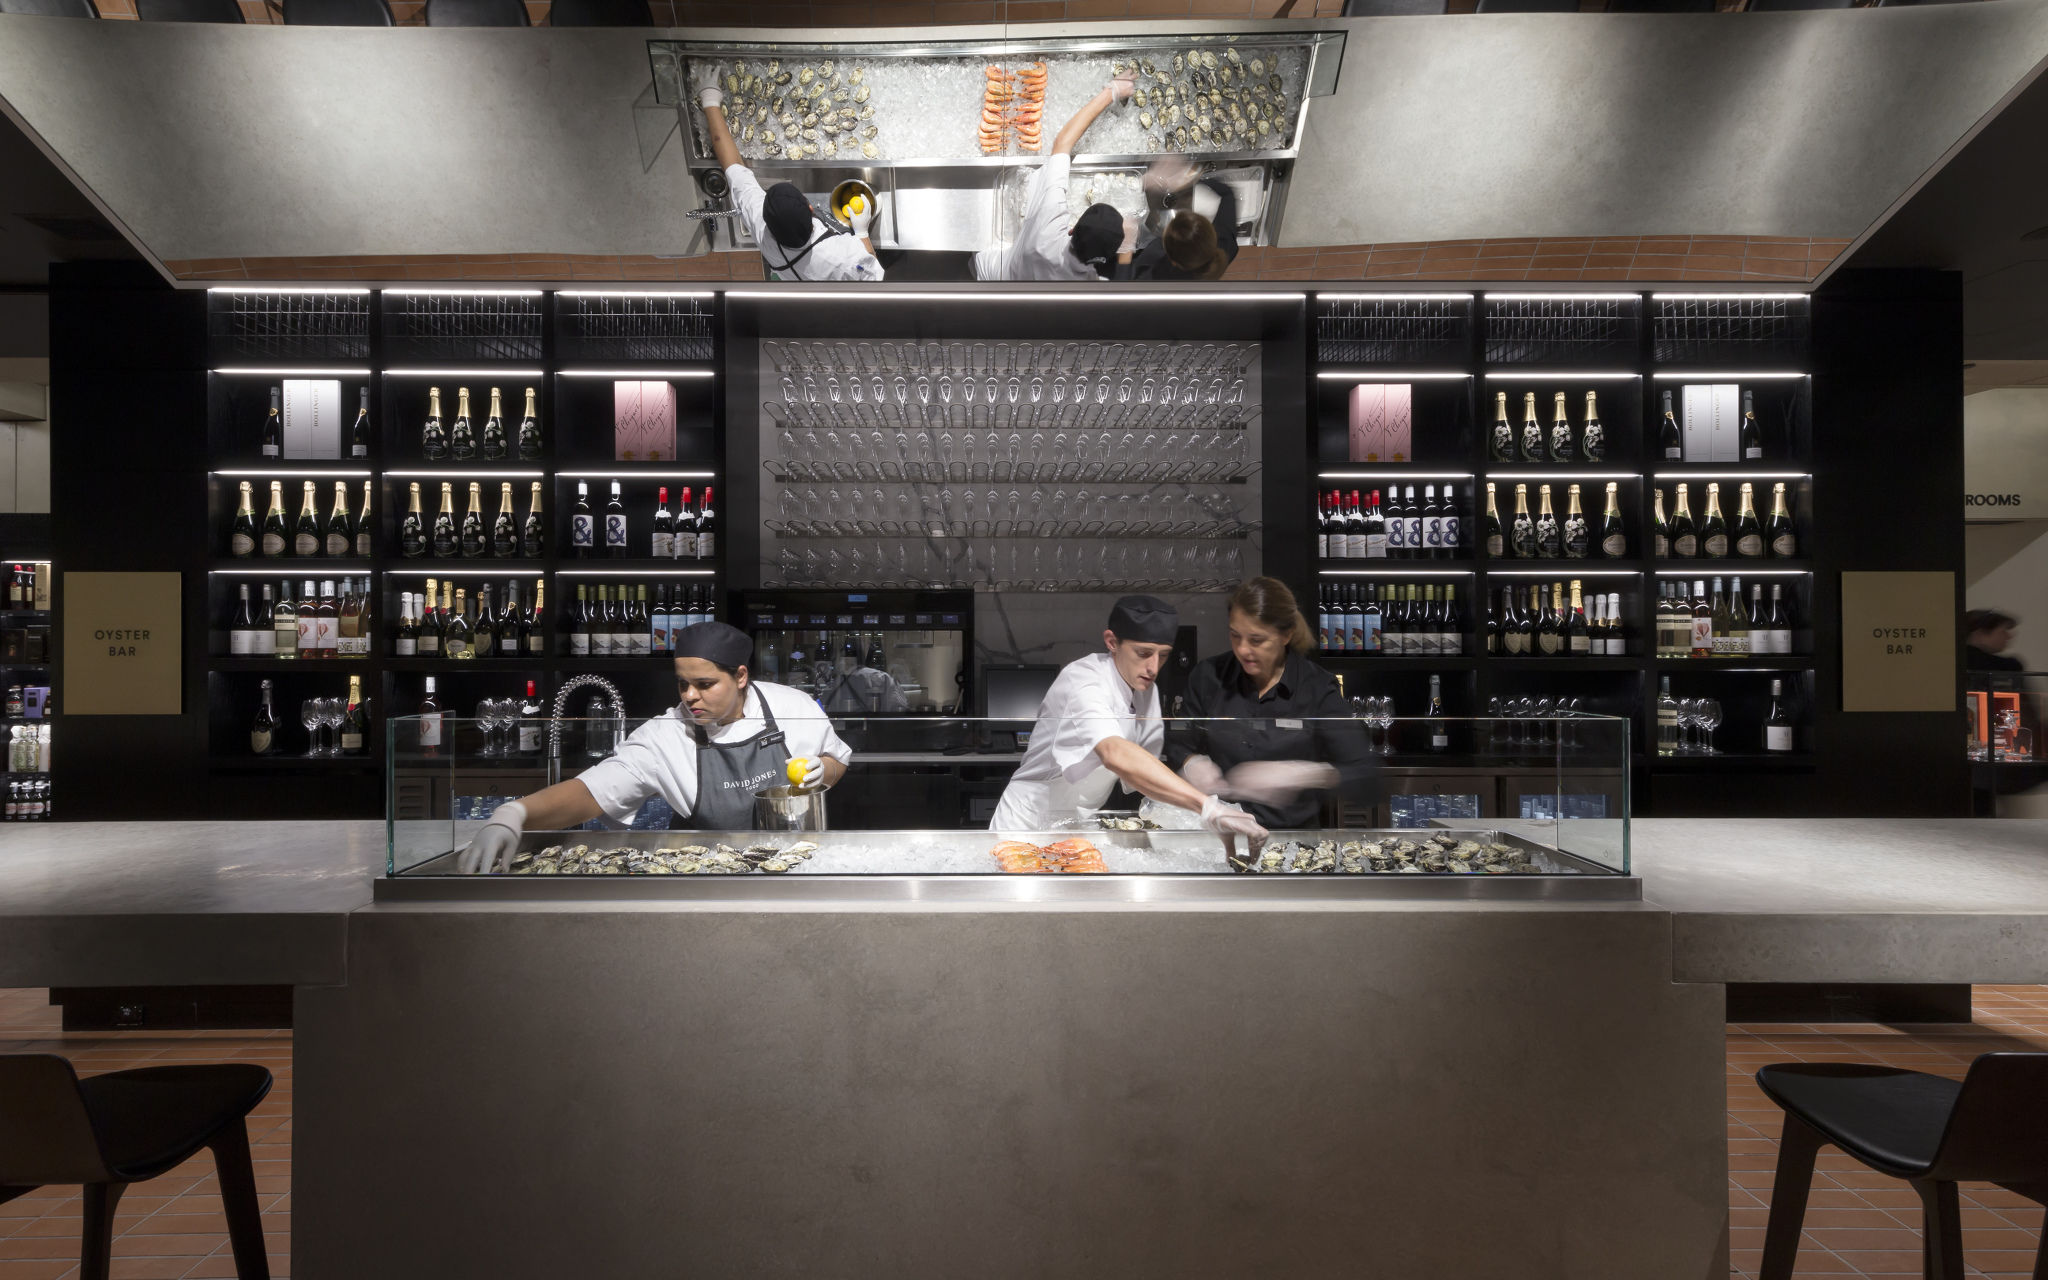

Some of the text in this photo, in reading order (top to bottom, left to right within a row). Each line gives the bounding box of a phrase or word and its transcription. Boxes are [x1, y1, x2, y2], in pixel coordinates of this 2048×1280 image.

[1965, 494, 2020, 506] ROOMS
[95, 630, 150, 640] OYSTER
[1873, 628, 1926, 638] OYSTER
[109, 646, 136, 656] BAR
[1886, 644, 1913, 655] BAR
[724, 769, 777, 789] DAVID JONES
